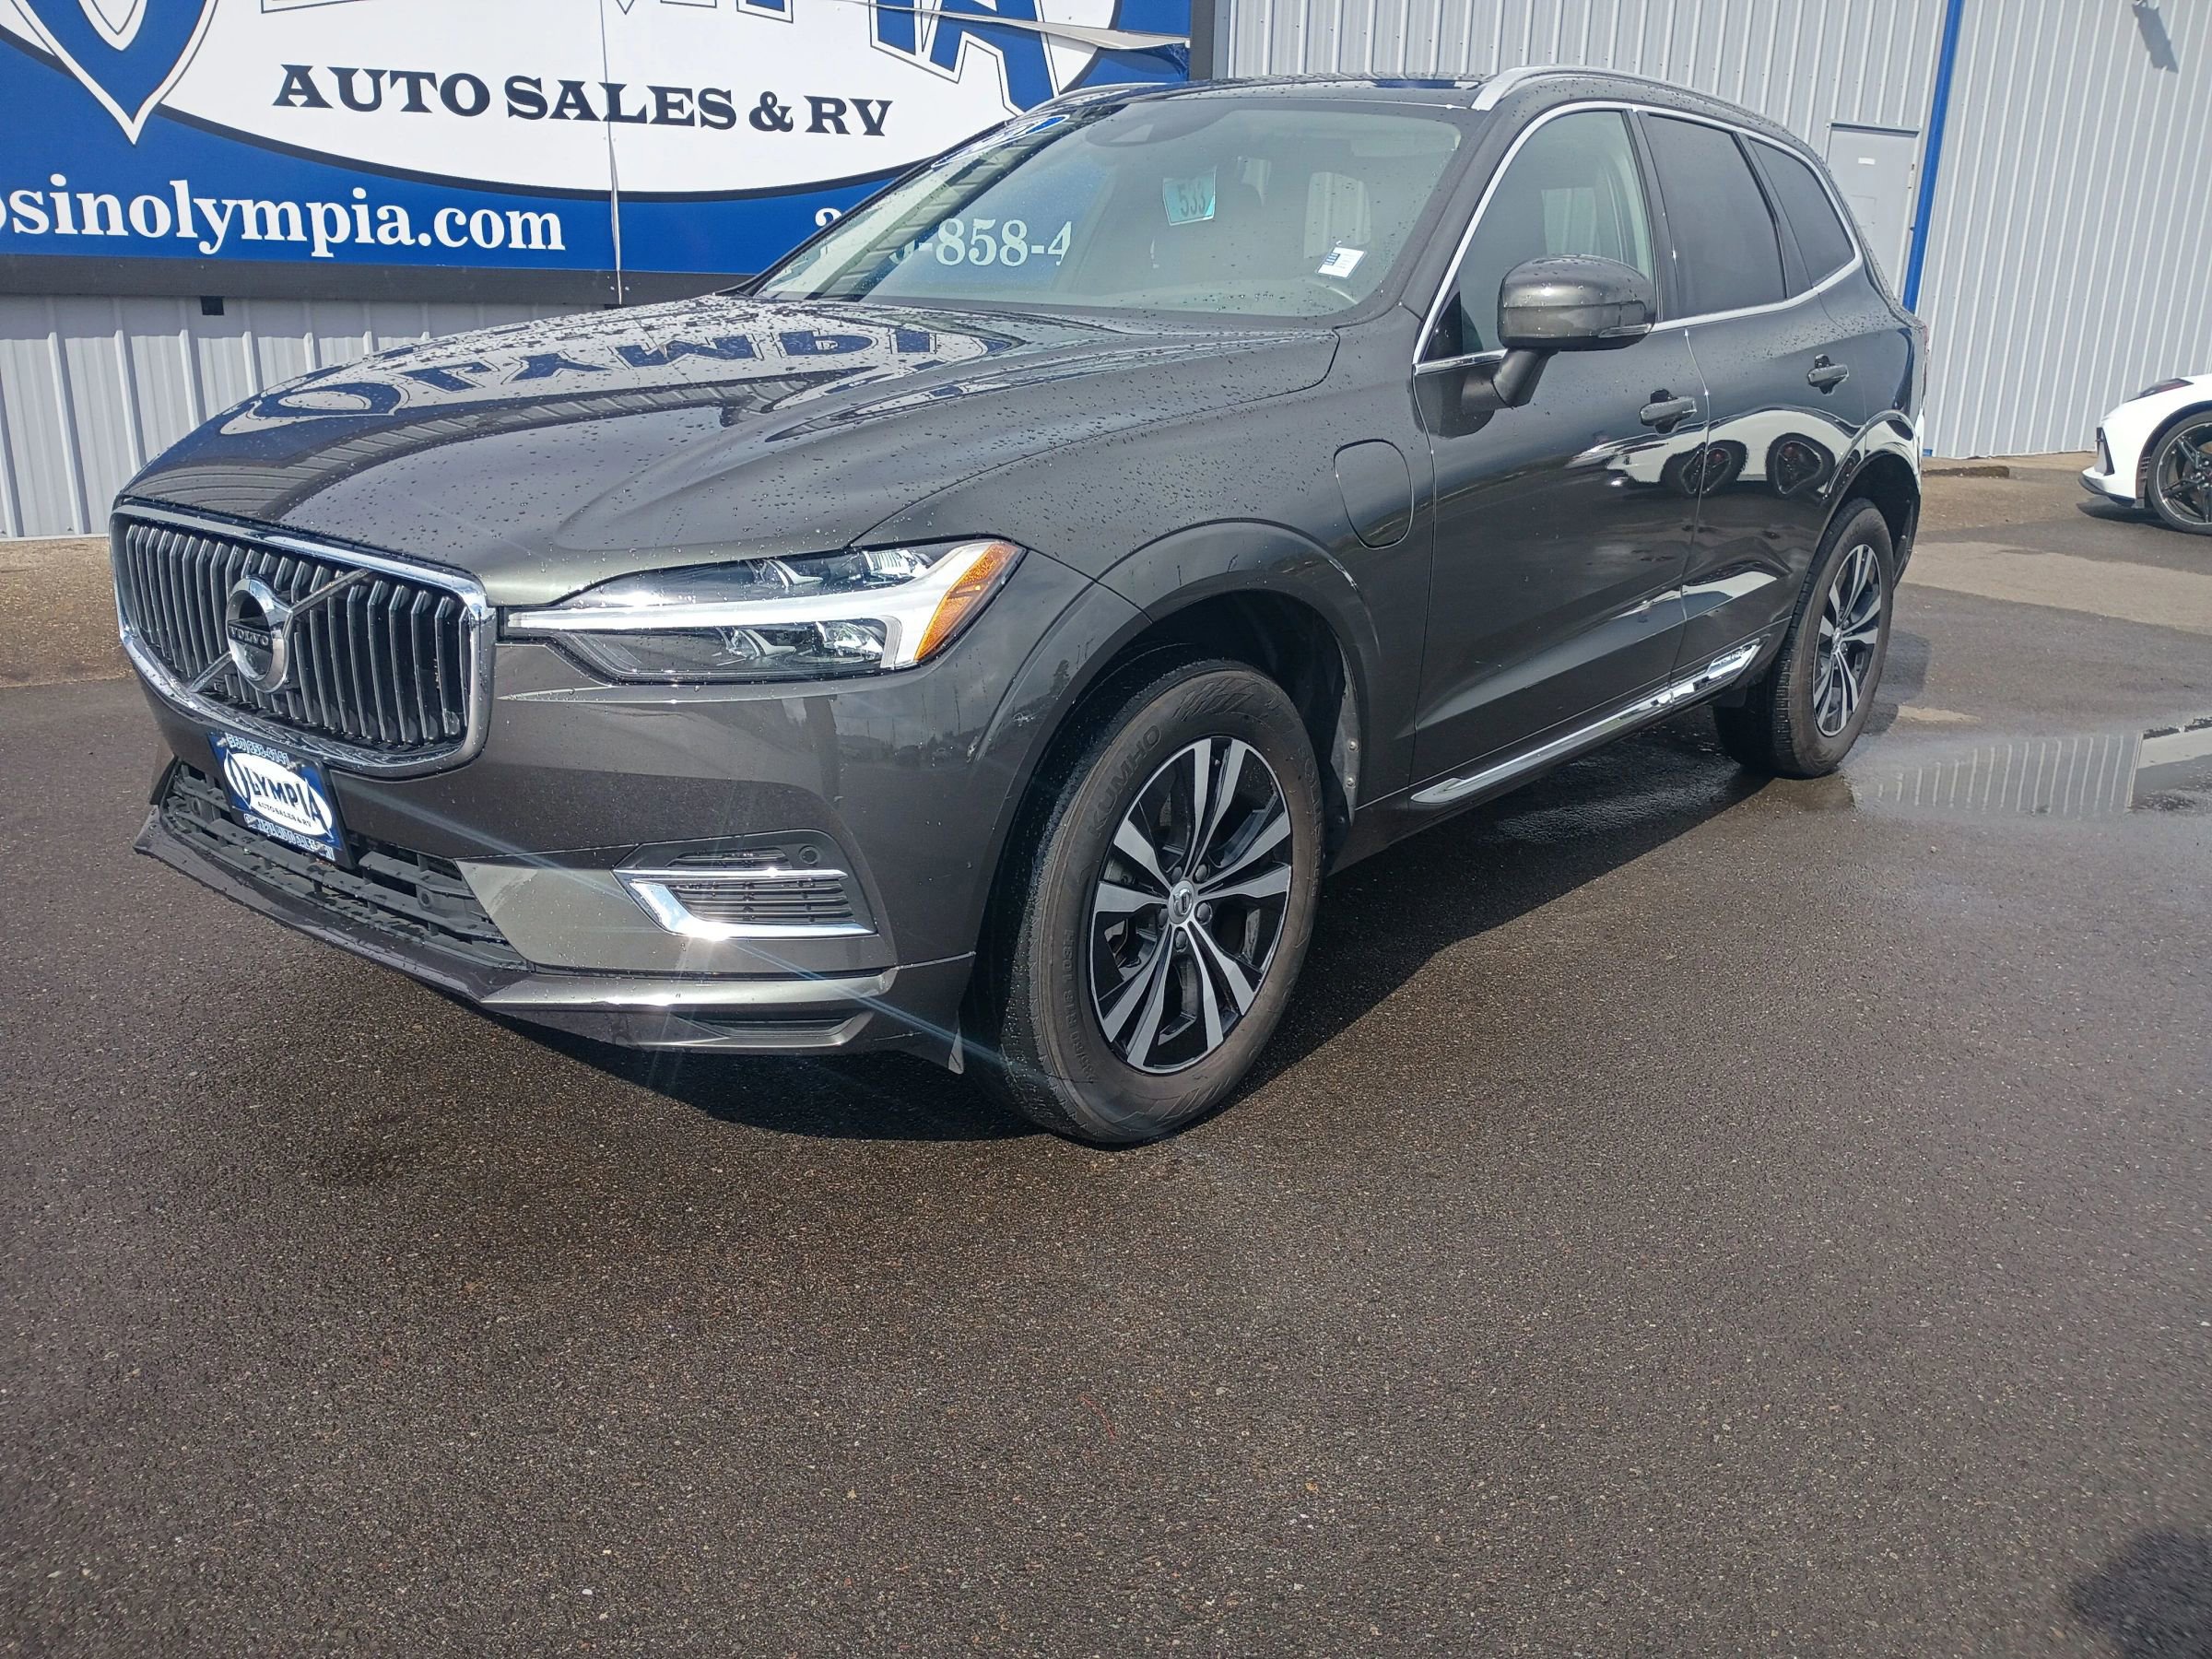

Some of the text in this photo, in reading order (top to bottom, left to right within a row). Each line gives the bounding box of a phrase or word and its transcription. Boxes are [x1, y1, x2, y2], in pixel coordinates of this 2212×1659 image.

[272, 64, 893, 136] AUTO SALES & RV
[0, 173, 566, 258] sinolympia.com
[229, 625, 270, 647] VOLVO
[226, 749, 335, 840] OLYMPIA
[1088, 724, 1161, 838] KUMHO
